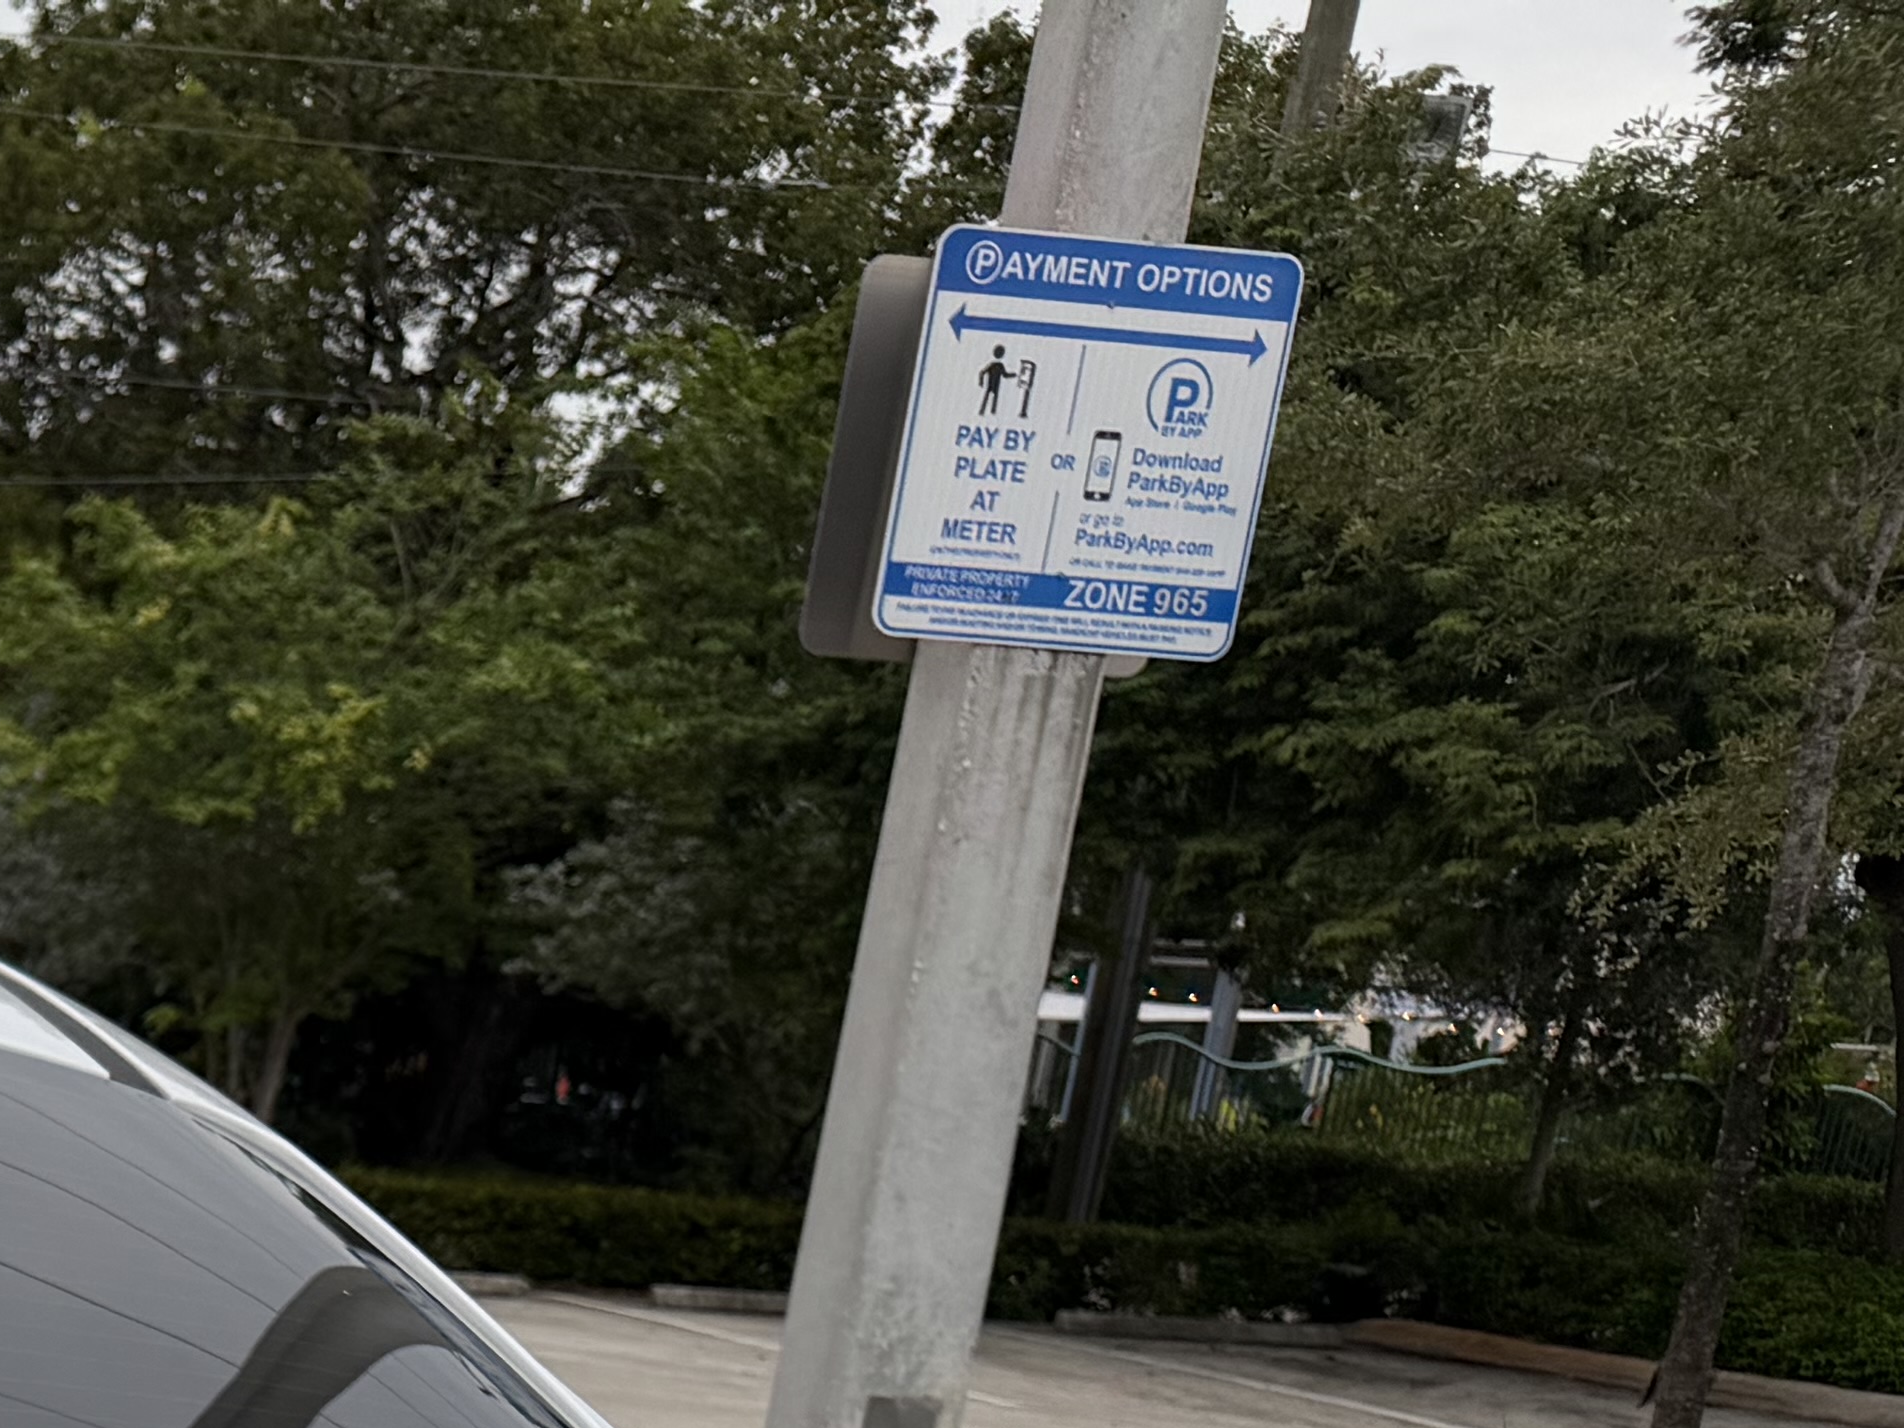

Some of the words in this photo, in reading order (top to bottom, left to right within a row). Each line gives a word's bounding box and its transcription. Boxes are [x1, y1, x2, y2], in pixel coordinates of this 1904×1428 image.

[966, 240, 1131, 289] PAYMENT
[1137, 263, 1274, 303] OPTIONS
[955, 424, 999, 449] PAY
[1003, 429, 1036, 452] BY
[1161, 425, 1177, 437] BY
[1178, 427, 1203, 438] APP
[954, 456, 1028, 483] PLATE
[1050, 453, 1075, 471] OR
[1132, 448, 1223, 473] Download
[1127, 472, 1229, 500] ParkByApp
[969, 489, 1000, 512] AT
[941, 518, 1017, 545] METER
[1075, 528, 1214, 557] ParkByApp.com
[904, 565, 958, 583] PRIVATE
[959, 570, 1031, 589] PROPERTY
[911, 581, 986, 600] ENFORCED
[1063, 579, 1149, 614] ZONE
[1153, 589, 1210, 617] 965
